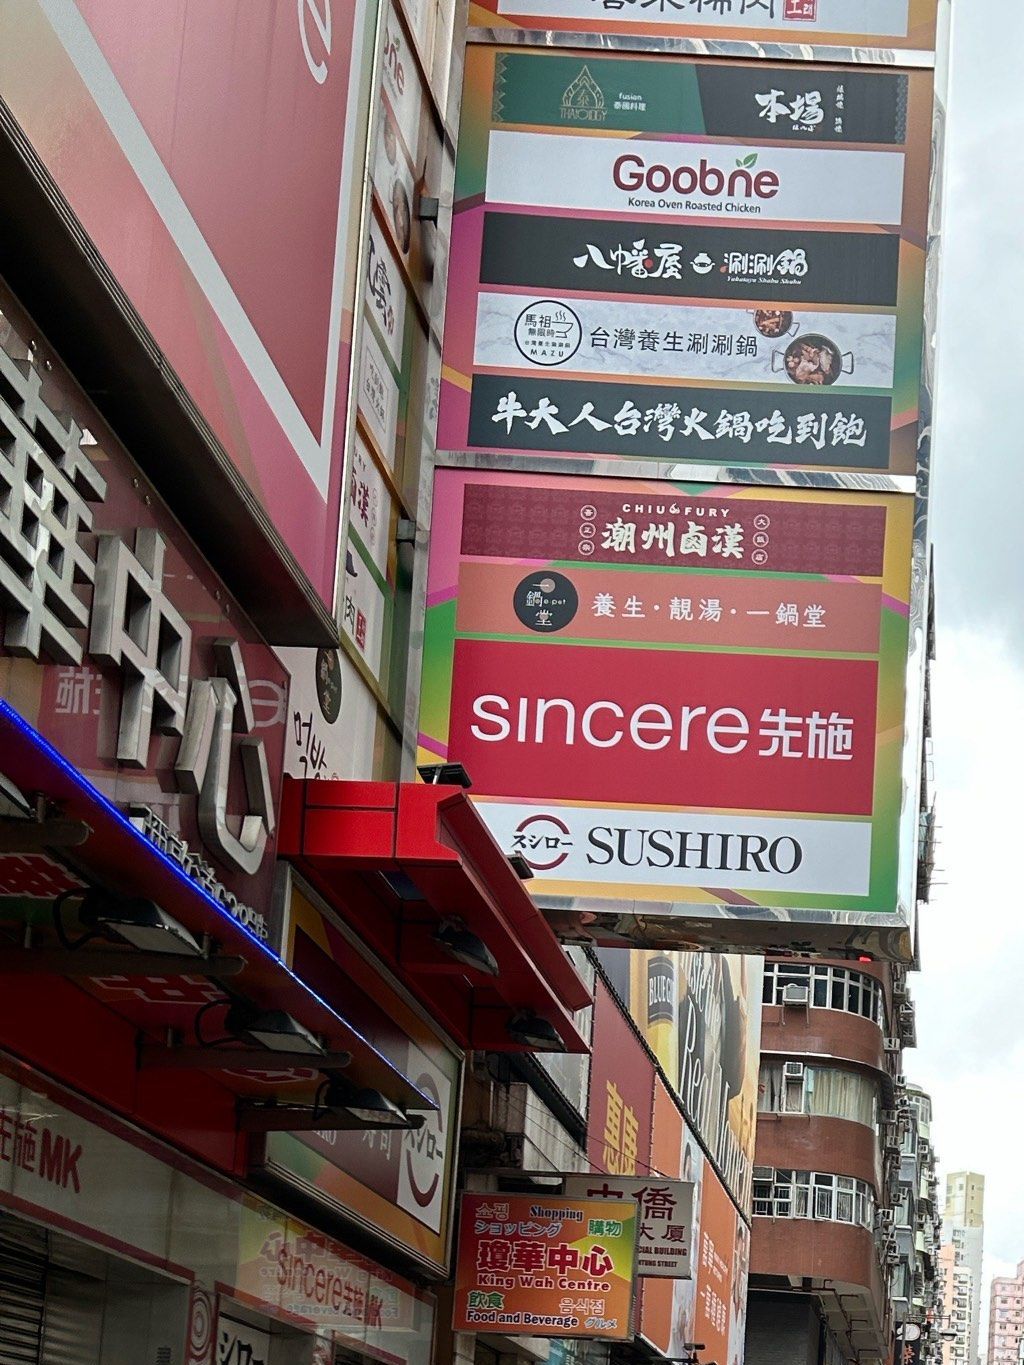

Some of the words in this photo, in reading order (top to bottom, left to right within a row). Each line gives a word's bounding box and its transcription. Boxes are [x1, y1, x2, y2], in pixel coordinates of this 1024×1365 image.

[754, 89, 824, 125] 本場
[612, 153, 780, 199] Goobne
[628, 197, 656, 209] Korea
[658, 199, 683, 210] Oven
[685, 200, 723, 212] Roasted
[724, 202, 761, 214] Chicken
[573, 238, 683, 280] 八幡屋
[724, 248, 808, 277] 涮涮鍋
[524, 313, 552, 327] 馬祖
[590, 326, 758, 358] 台灣養生涮涮鍋
[530, 349, 564, 358] MAZU
[491, 390, 867, 451] 牛大人台灣火鍋吃到飽
[622, 503, 666, 515] CHIU
[684, 506, 731, 518] FURY
[471, 693, 751, 754] sincere
[758, 708, 854, 762] 先施
[510, 832, 575, 852] スシロー
[586, 827, 802, 875] SUSHIRO
[39, 1128, 83, 1194] MK
[475, 1202, 510, 1221] 쇼핑
[529, 1204, 584, 1222] Shopping
[474, 1220, 562, 1237] ショッピング
[588, 1219, 623, 1238] 購物
[476, 1239, 615, 1277] 瓊華中心
[654, 1246, 688, 1257] BUILDING
[657, 1260, 678, 1268] STREET
[478, 1273, 515, 1289] King
[519, 1274, 554, 1289] Wah
[558, 1278, 612, 1292] Centre
[467, 1290, 506, 1310] 飲食
[559, 1297, 605, 1316] 음식점
[466, 1310, 497, 1323] Food
[498, 1311, 522, 1324] and
[523, 1313, 579, 1329] Beverage
